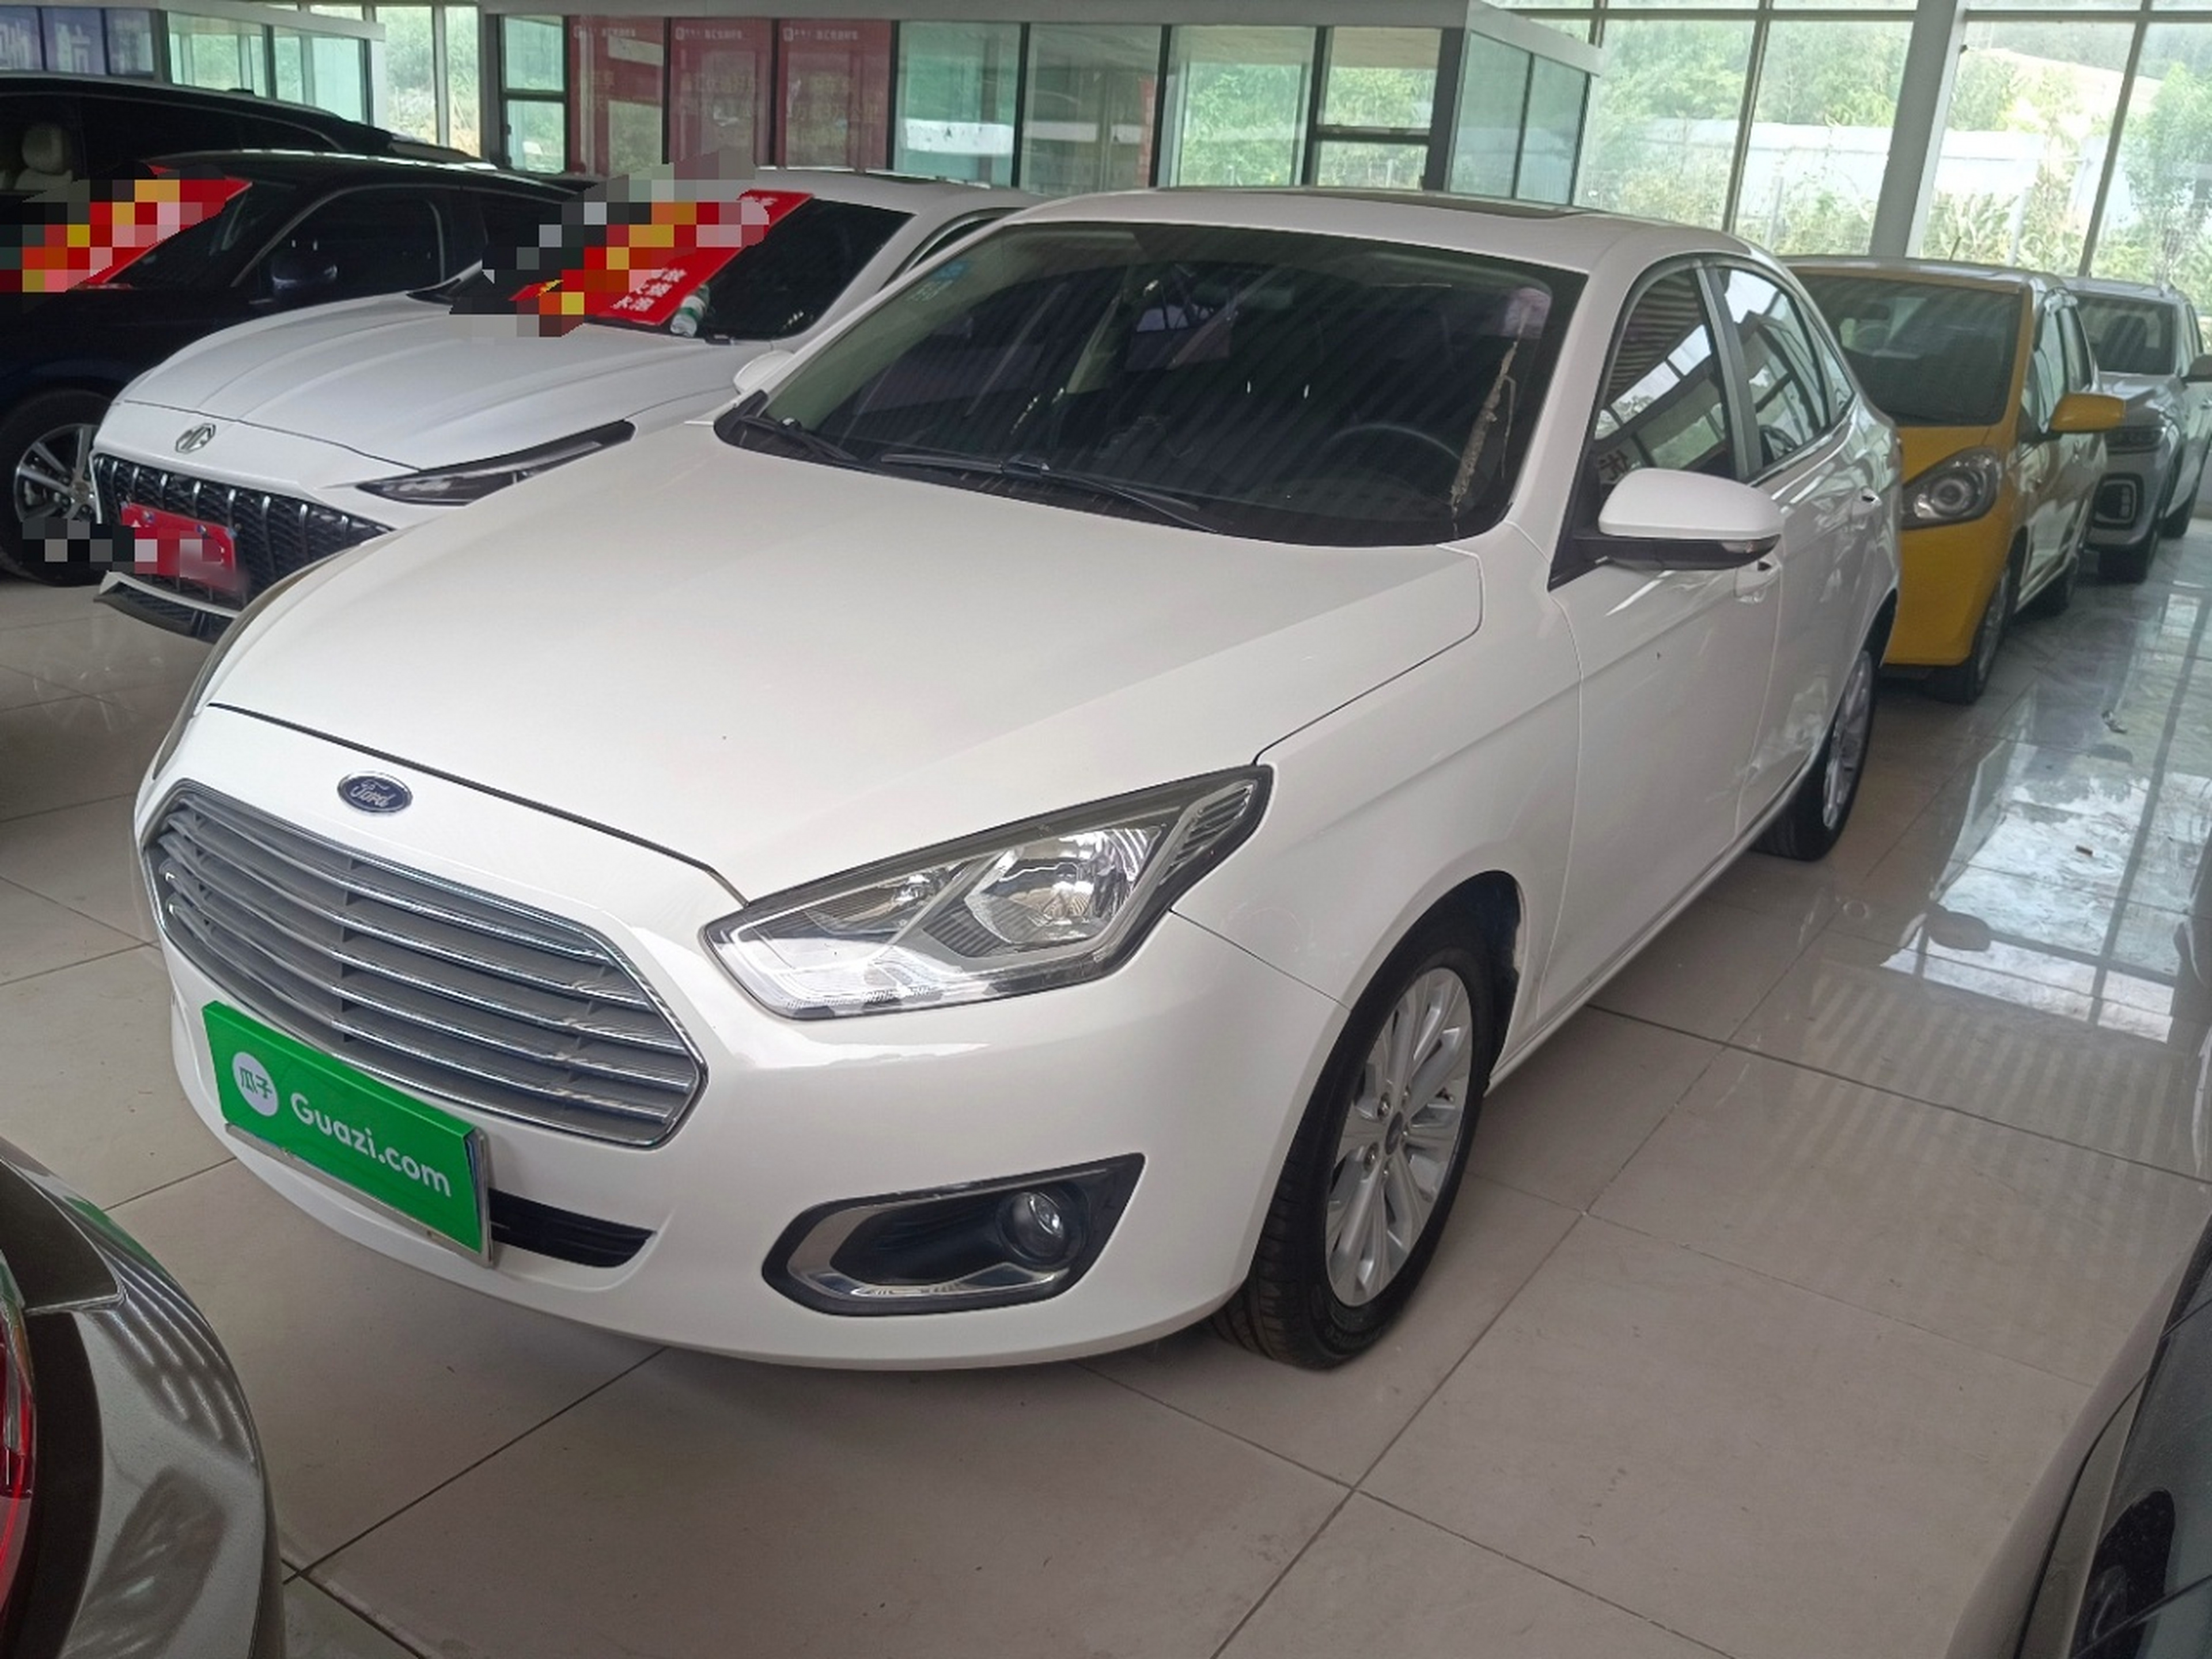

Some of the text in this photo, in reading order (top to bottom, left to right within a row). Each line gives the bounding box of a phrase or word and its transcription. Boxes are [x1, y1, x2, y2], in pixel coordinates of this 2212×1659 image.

[350, 778, 396, 807] Ford
[239, 1067, 272, 1099] 瓜子
[291, 1092, 452, 1197] Guazi.com
